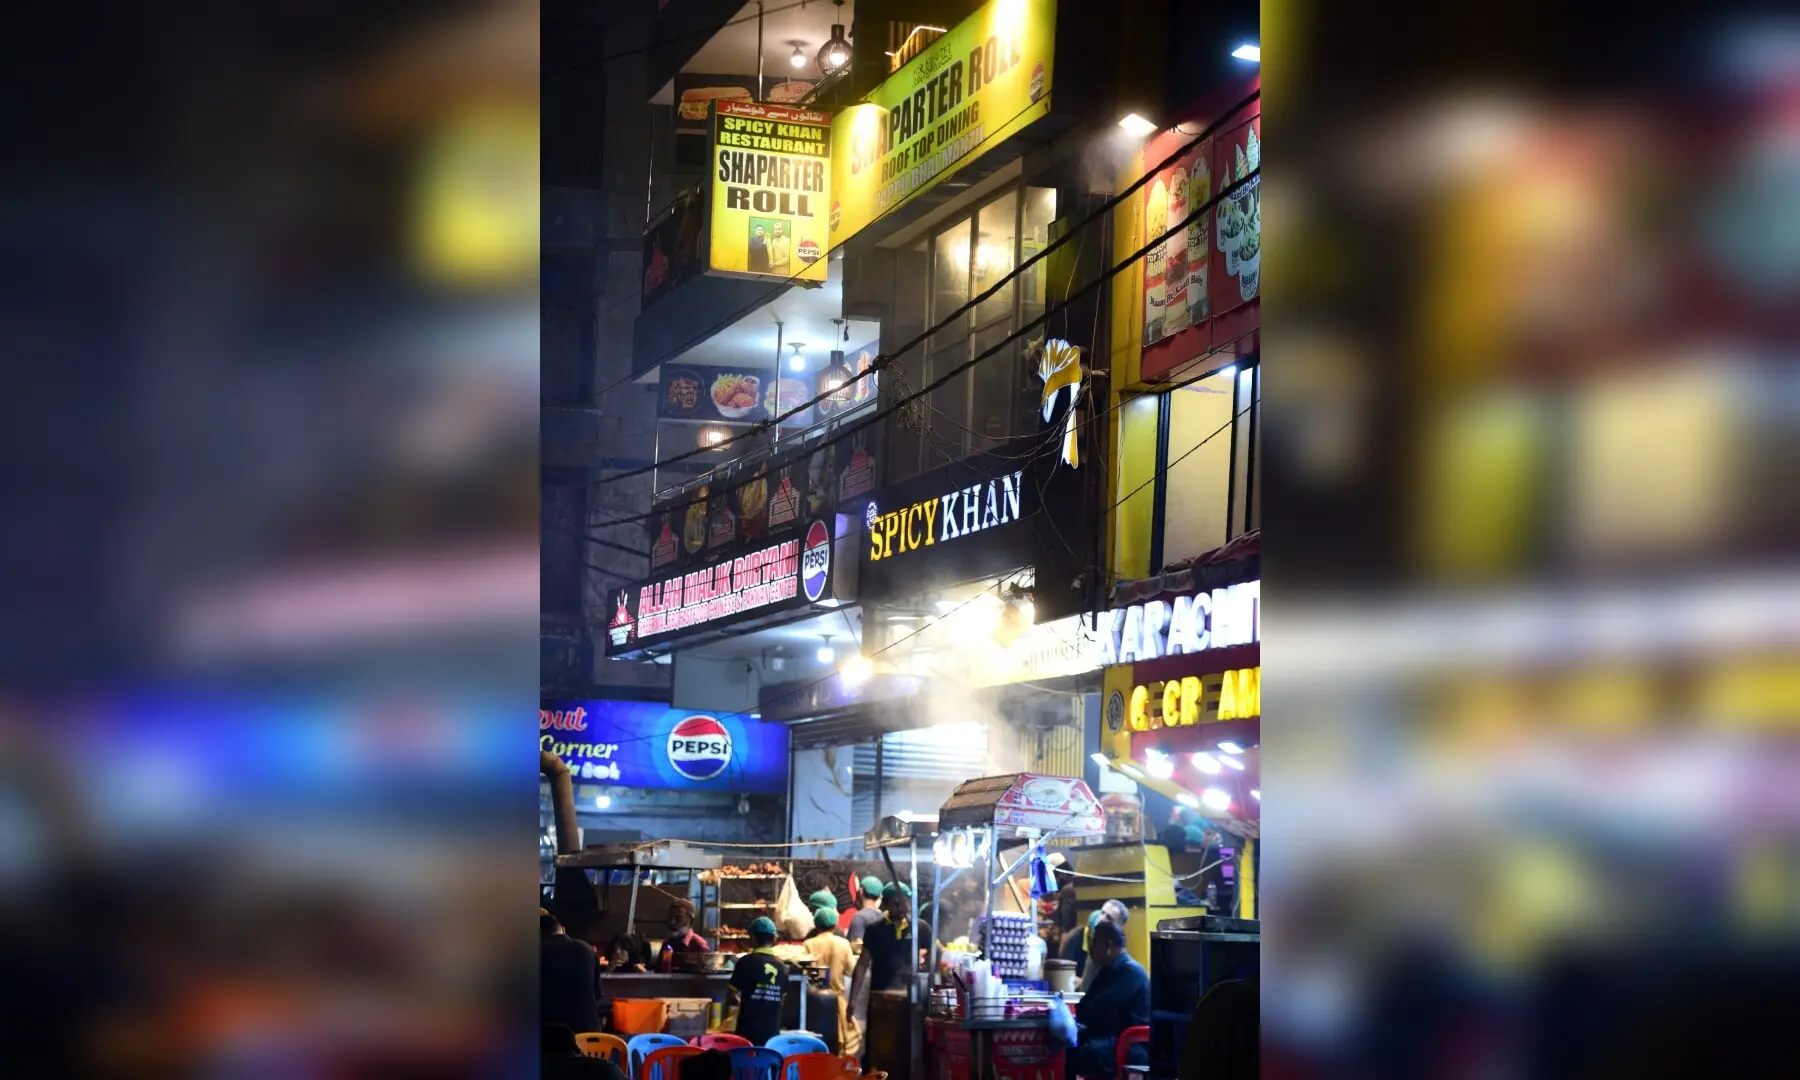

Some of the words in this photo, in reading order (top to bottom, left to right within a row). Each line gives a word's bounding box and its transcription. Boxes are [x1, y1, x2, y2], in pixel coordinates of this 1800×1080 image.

[724, 117, 775, 134] SPICY
[777, 124, 822, 141] KHAN
[720, 131, 825, 155] RESTAURANT
[882, 145, 911, 184] ROOF
[912, 131, 934, 163] TOP
[937, 101, 979, 148] DINING
[719, 150, 824, 193] SHAPARTER
[727, 186, 814, 217] ROLL
[798, 248, 820, 256] PEPSI
[870, 498, 939, 561] SPICY
[940, 470, 1023, 542] KHAN
[805, 547, 829, 570] PEPSI
[638, 576, 682, 619] ALLAH
[684, 560, 732, 607] MALIK
[733, 539, 799, 593] BIRYANI
[540, 734, 619, 759] Corner
[672, 739, 728, 755] PEPSI
